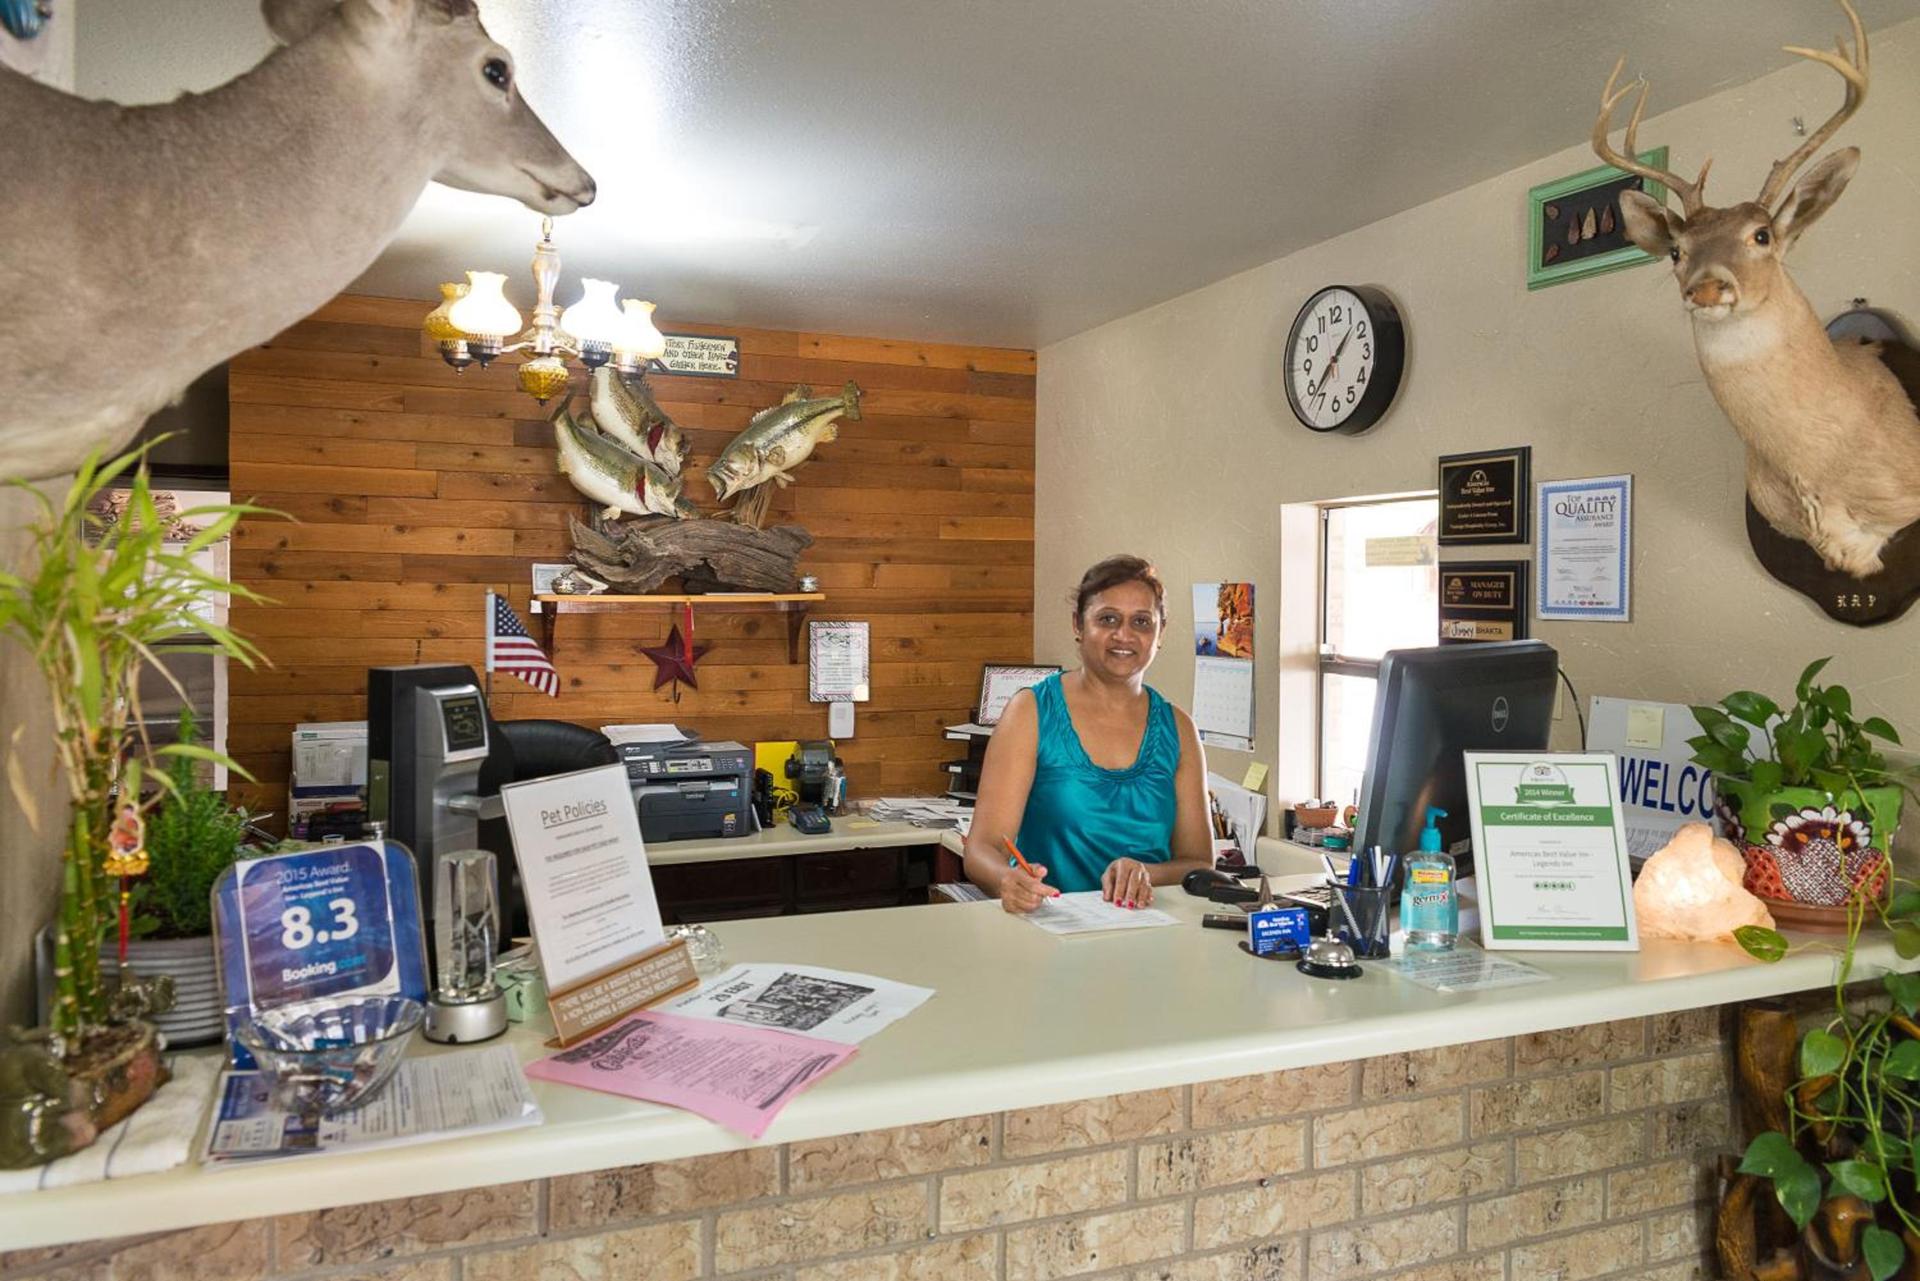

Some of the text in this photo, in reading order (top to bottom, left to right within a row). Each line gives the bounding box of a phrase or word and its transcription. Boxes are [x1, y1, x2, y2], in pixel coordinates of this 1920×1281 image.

[1329, 305, 1343, 324] 12
[1318, 316, 1325, 334] 11
[1357, 320, 1366, 339] 2
[1306, 335, 1318, 353] 10
[1363, 343, 1370, 360] 3
[1303, 359, 1312, 375] 9
[1357, 366, 1366, 384] 4
[1307, 380, 1316, 396] 8
[1346, 386, 1356, 403] 5
[1318, 392, 1326, 411] 7
[1332, 395, 1340, 412] 6
[1555, 500, 1616, 518] QUALITY
[1470, 581, 1505, 589] MANAGER
[541, 800, 608, 825] Pet Policies
[1500, 811, 1595, 822] Certificate of Excellence
[275, 860, 349, 885] 2015 Award
[281, 897, 359, 950] 8.3
